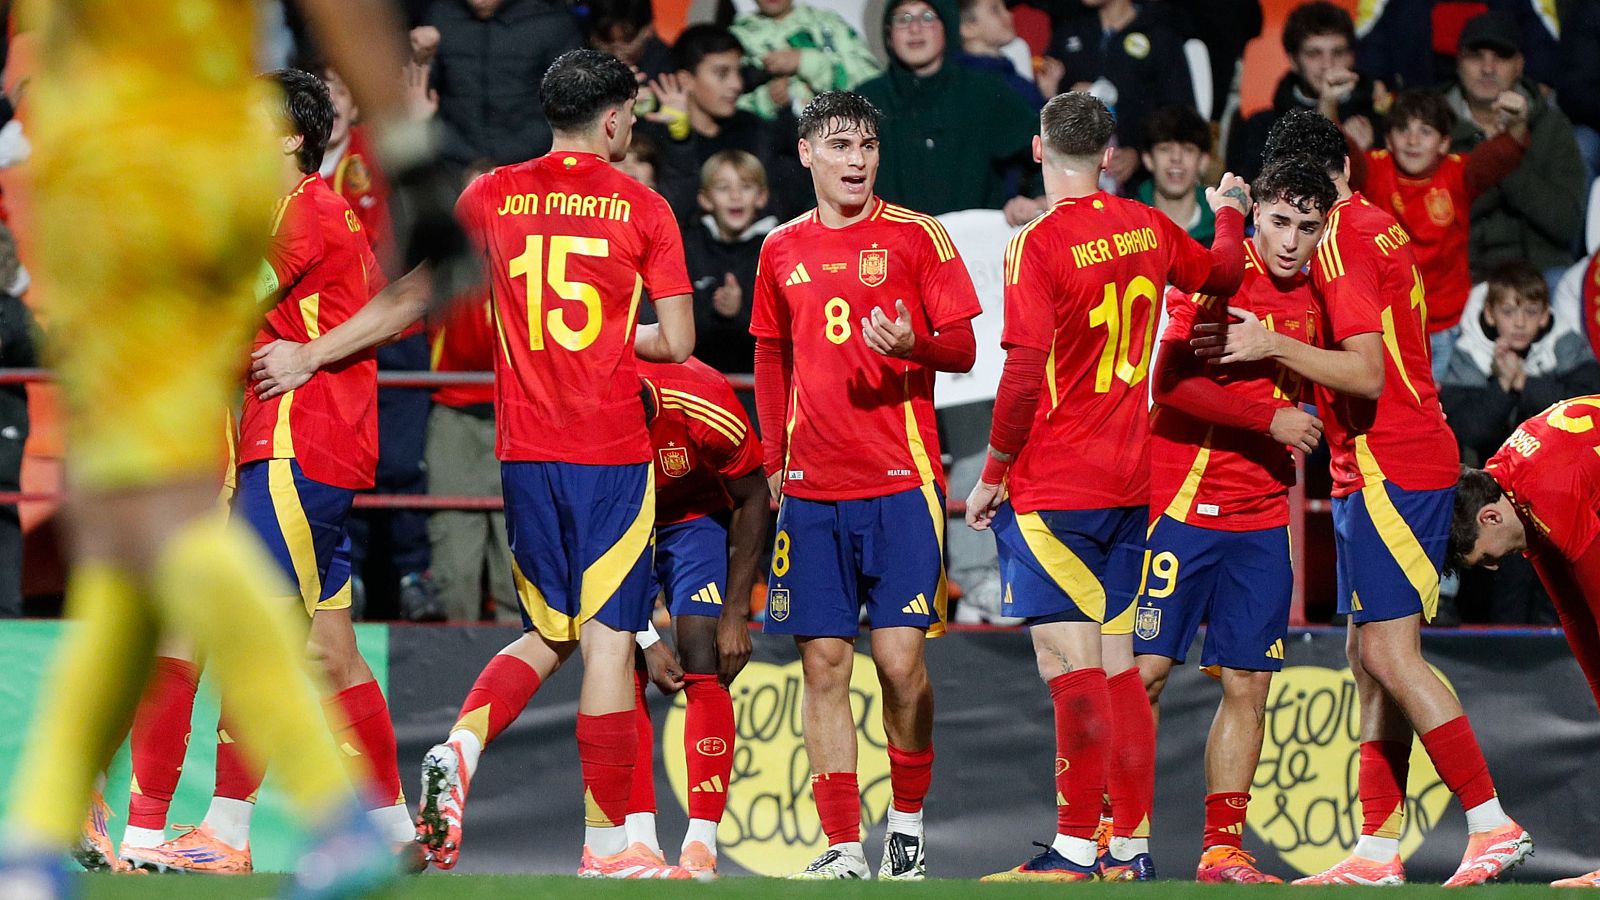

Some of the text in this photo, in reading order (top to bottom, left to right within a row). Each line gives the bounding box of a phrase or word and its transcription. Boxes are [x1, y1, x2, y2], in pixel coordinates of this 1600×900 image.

[498, 192, 631, 223] JON MARTÍN
[1071, 226, 1158, 269] IKER BRAVO
[509, 234, 609, 352] 15
[824, 296, 852, 345] 8
[1088, 275, 1158, 393] 10
[771, 529, 791, 577] 8
[1138, 549, 1179, 598] 19
[730, 745, 762, 786] e
[1252, 748, 1318, 790] de
